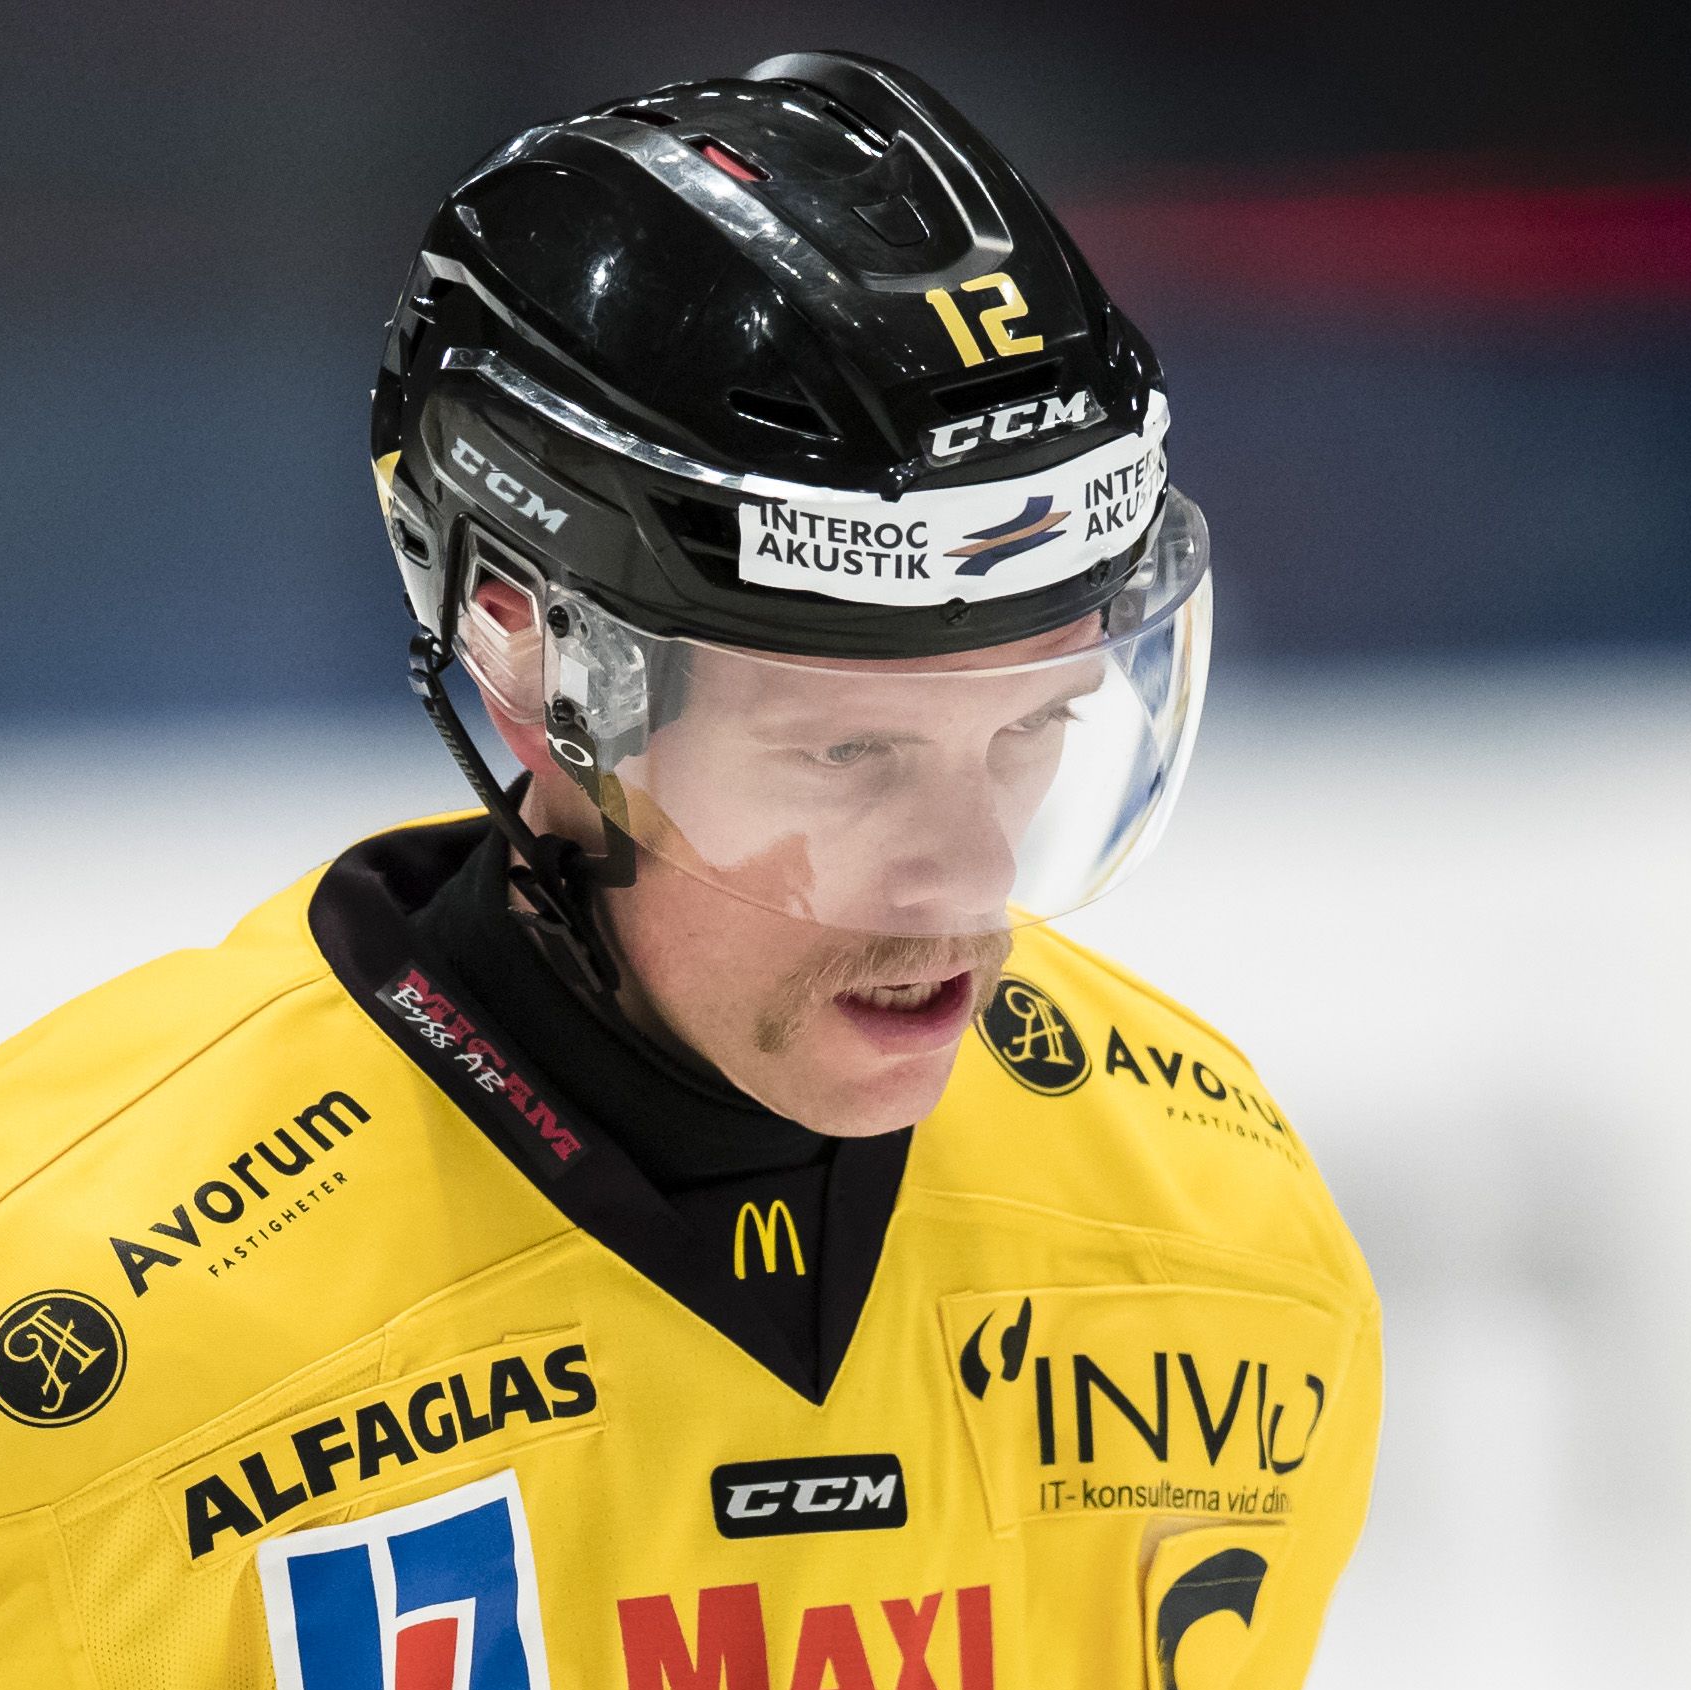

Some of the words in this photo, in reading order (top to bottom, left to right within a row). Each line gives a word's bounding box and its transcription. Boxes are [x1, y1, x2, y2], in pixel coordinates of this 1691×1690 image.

[925, 272, 1044, 367] 12
[929, 391, 1088, 457] CCM
[451, 437, 571, 535] CCM
[758, 502, 928, 548] INTEROC
[756, 532, 931, 580] AKUSTIK
[454, 1052, 505, 1093] AB
[1106, 1025, 1296, 1150] Avoru
[109, 1090, 371, 1297] Avorum
[208, 1171, 347, 1277] FASTIGHETER
[185, 1344, 597, 1560] ALFAGLAS
[725, 1474, 898, 1519] CCM
